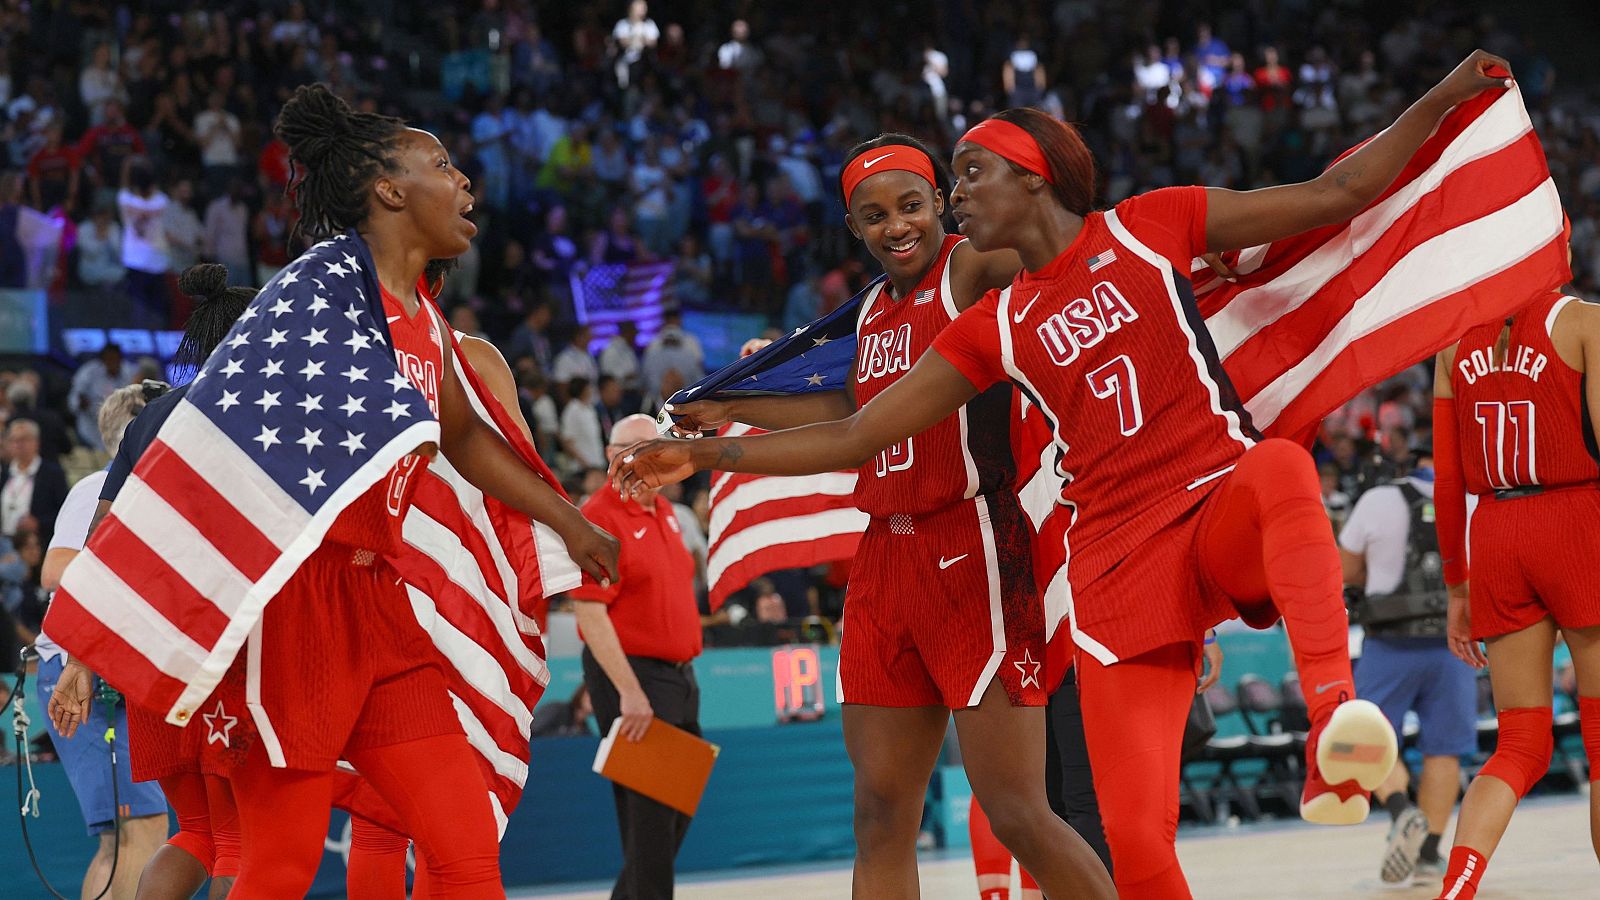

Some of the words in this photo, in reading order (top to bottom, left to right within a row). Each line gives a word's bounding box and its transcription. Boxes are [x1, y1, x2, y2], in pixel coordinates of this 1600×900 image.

[857, 323, 911, 383] USA
[1036, 281, 1139, 367] USA
[1458, 344, 1548, 385] COLLIER
[1085, 354, 1143, 437] 7
[1475, 400, 1540, 489] 11
